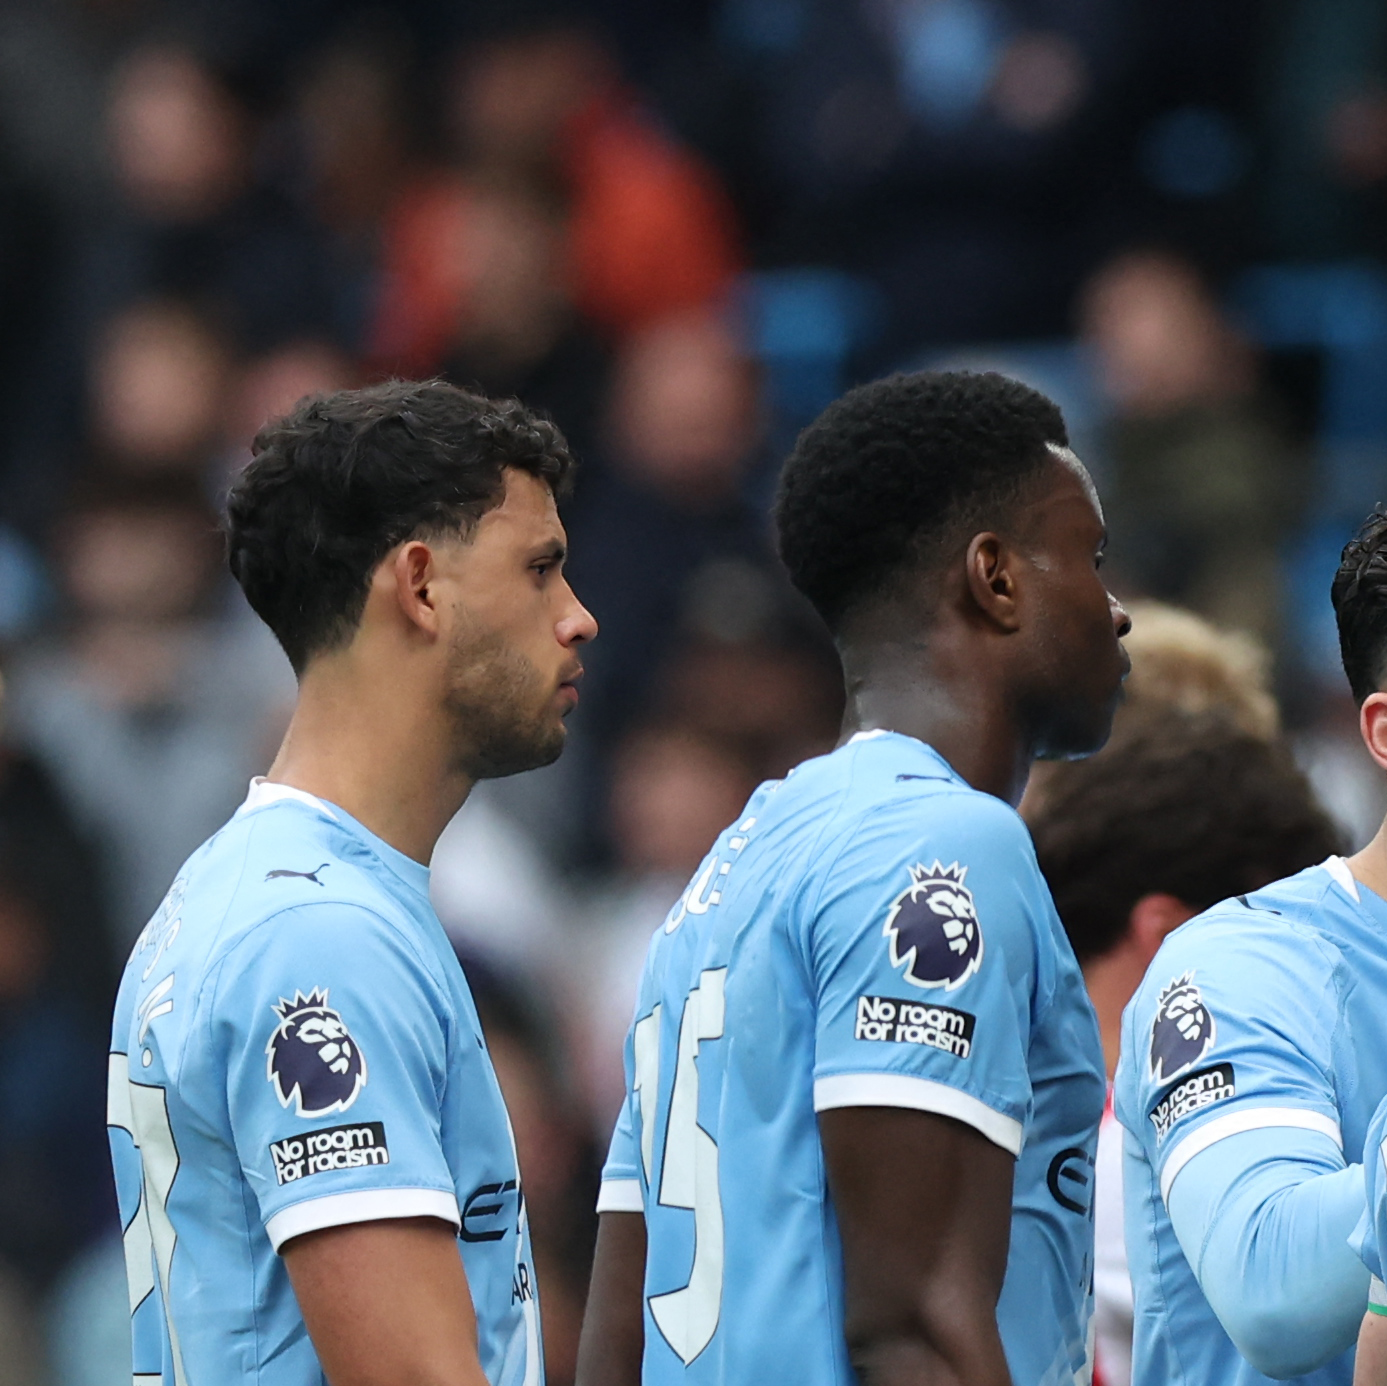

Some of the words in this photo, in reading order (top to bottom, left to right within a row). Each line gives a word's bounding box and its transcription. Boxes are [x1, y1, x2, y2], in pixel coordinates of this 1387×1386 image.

[858, 996, 896, 1021] No
[899, 1004, 965, 1036] room
[855, 1017, 893, 1041] for
[895, 1023, 970, 1059] racism
[1149, 1101, 1169, 1125] No
[1169, 1070, 1224, 1109] room
[1169, 1084, 1235, 1126] racism
[270, 1139, 304, 1165] No
[306, 1127, 375, 1156] room
[275, 1159, 305, 1185] for
[307, 1146, 390, 1175] racism
